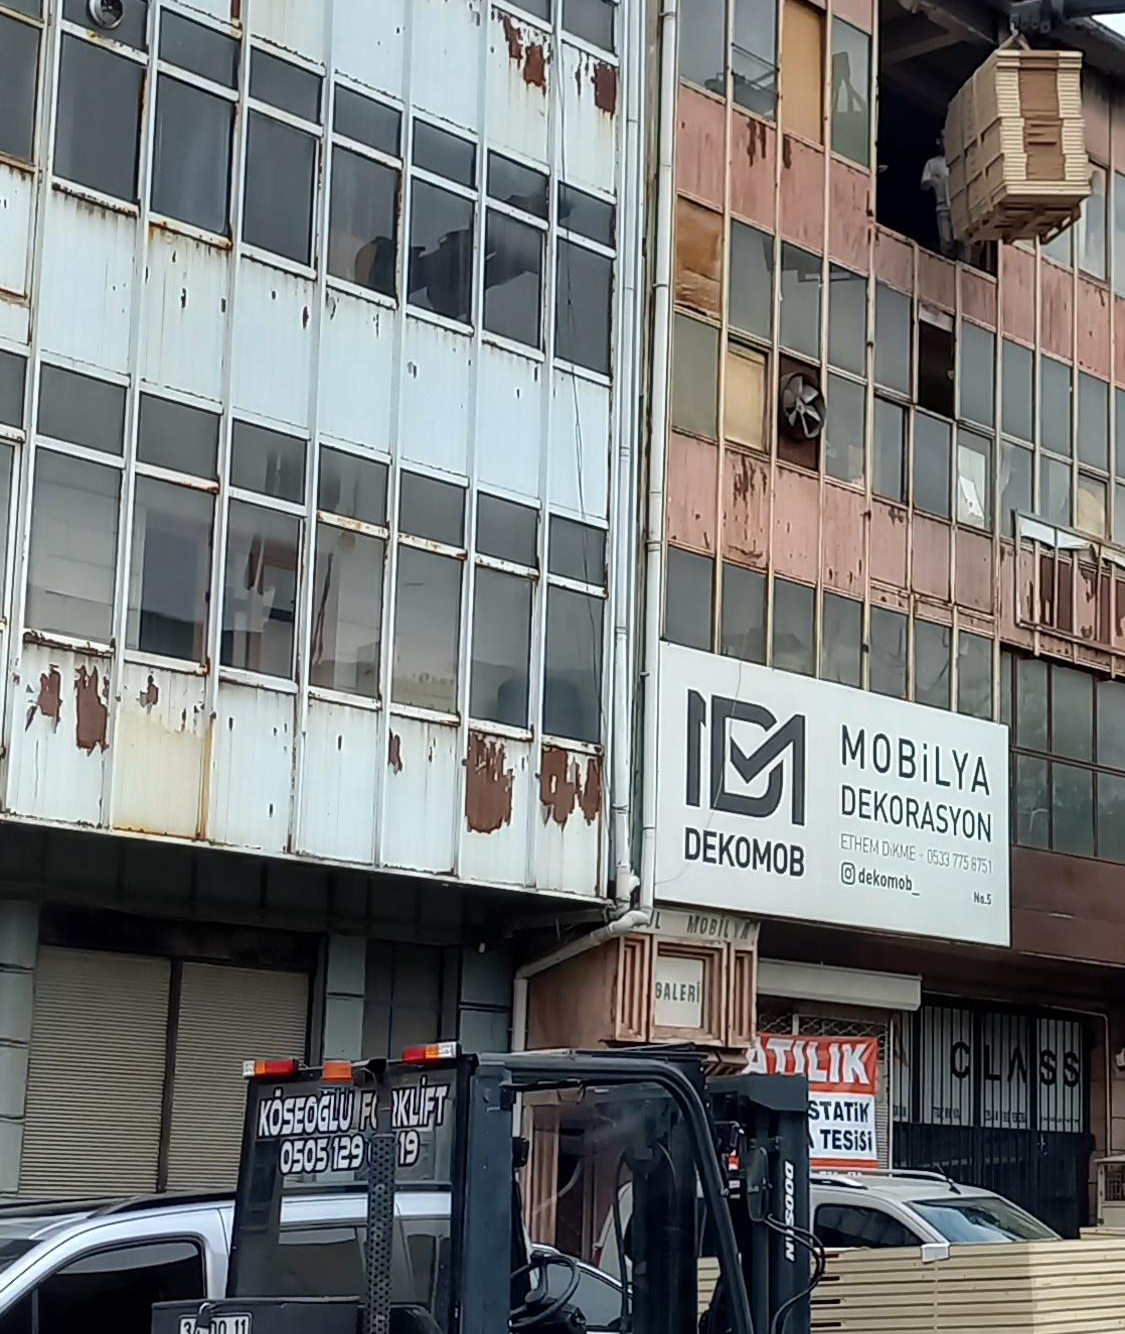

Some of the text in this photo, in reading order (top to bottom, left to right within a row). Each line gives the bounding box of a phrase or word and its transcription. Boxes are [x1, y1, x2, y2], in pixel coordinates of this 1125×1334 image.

[841, 784, 991, 842] DEKORASYON
[684, 827, 805, 877] DEKOMOB
[840, 833, 879, 854] ETHEM
[927, 849, 950, 867] 0533
[952, 853, 969, 871] 775
[971, 857, 992, 874] 8751
[259, 1087, 355, 1138] KÖSEOĞLU
[280, 1138, 329, 1175] 0505
[331, 1133, 365, 1172] 129
